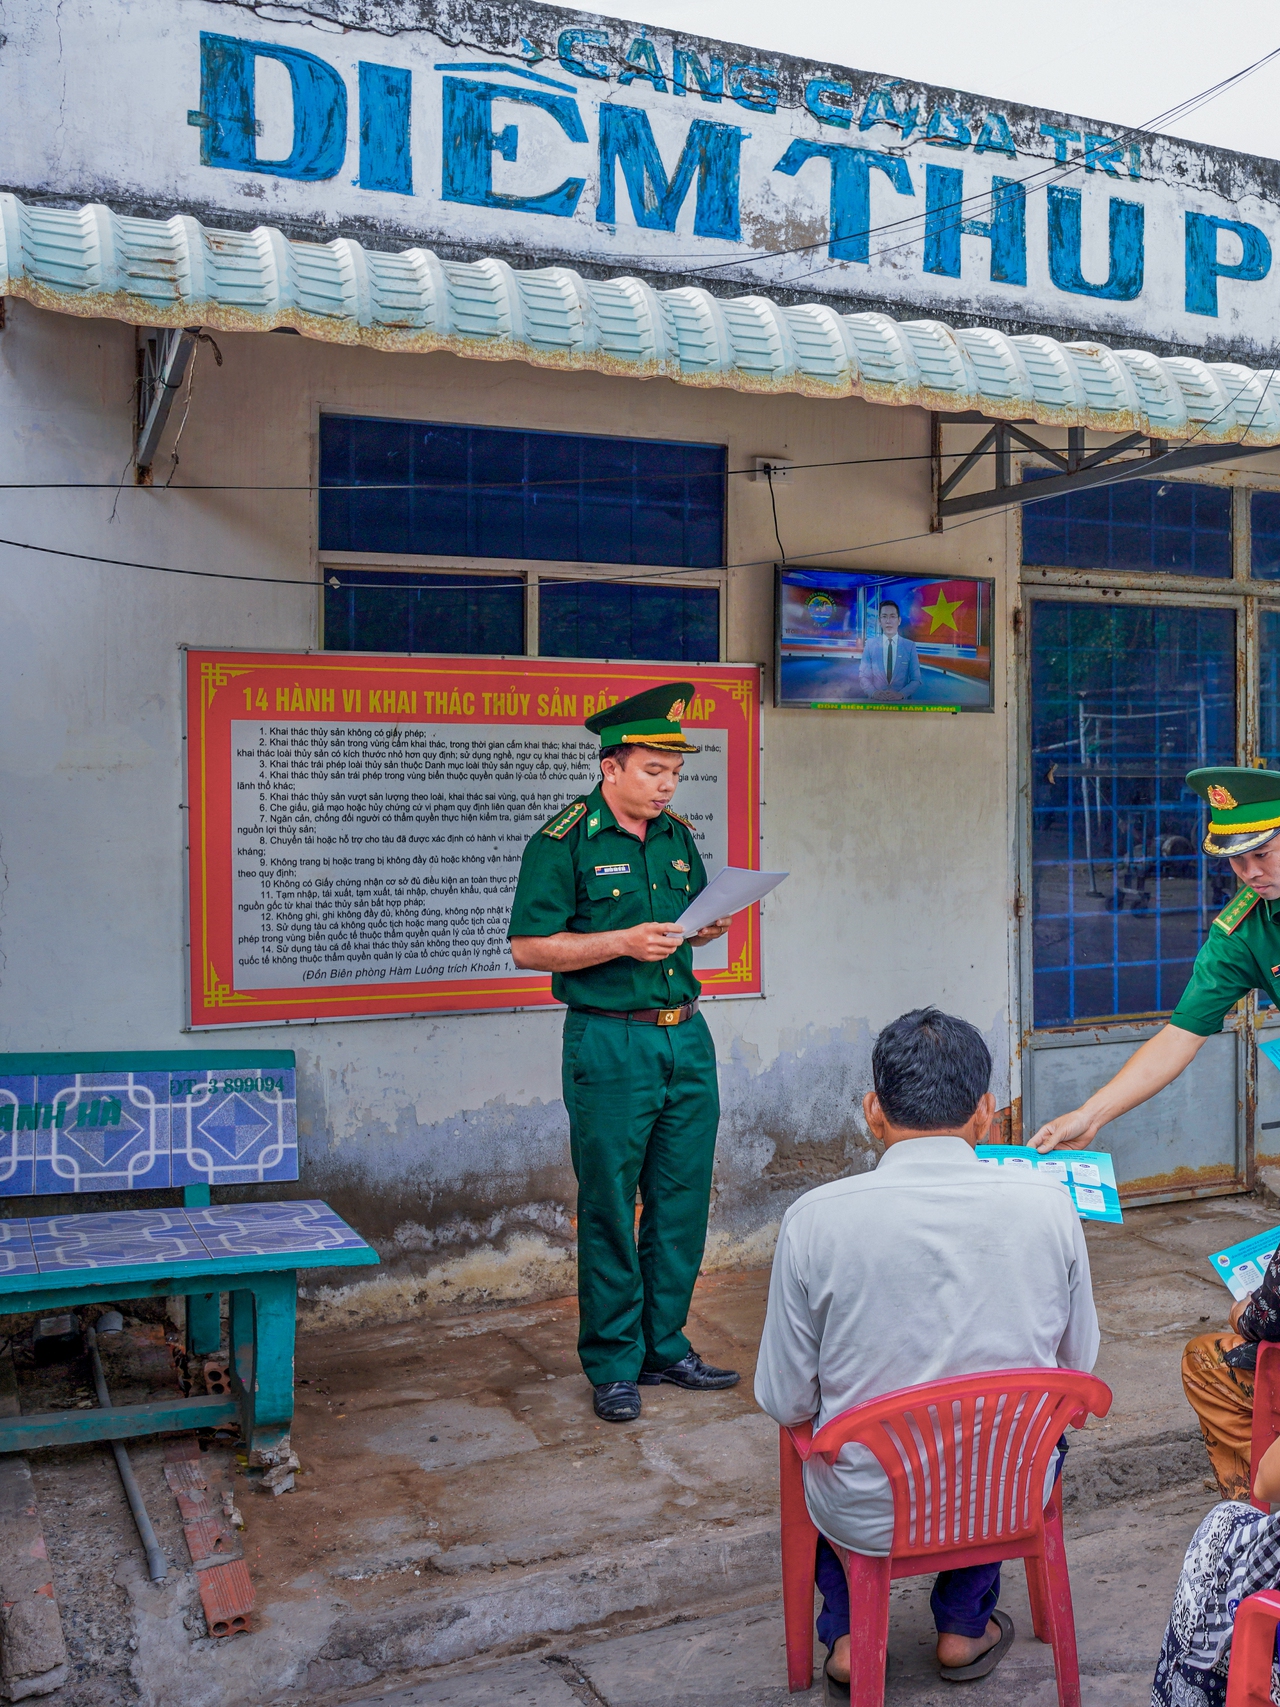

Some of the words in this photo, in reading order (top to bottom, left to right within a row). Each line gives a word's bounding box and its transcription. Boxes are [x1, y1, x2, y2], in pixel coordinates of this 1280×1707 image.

[1040, 123, 1141, 183] TRI
[773, 138, 1145, 301] THU
[243, 687, 268, 711] 14
[276, 683, 334, 712] HÀNH
[342, 689, 361, 713] VI
[369, 690, 417, 714] KHAI
[424, 686, 475, 715] THÁC
[482, 685, 531, 716] THỦY
[538, 686, 577, 718] SẢN
[290, 727, 309, 735] thác
[310, 727, 328, 737] thủy
[330, 728, 345, 736] sản
[347, 728, 372, 738] không
[374, 728, 384, 736] có
[310, 738, 328, 748] thủy
[330, 739, 345, 747] sản
[347, 740, 368, 749] trong
[370, 740, 390, 749] vùng
[391, 739, 409, 748] cấm
[449, 740, 470, 749] trong
[488, 740, 505, 750] gian
[506, 740, 523, 748] cấm
[326, 760, 346, 770] phép
[364, 760, 382, 770] thủy
[384, 760, 399, 768] sản
[400, 760, 422, 770] thuộc
[481, 761, 498, 771] thủy
[499, 761, 514, 769] sản
[515, 763, 534, 771] nguy
[236, 781, 256, 789] lãnh
[257, 780, 271, 789] thổ
[237, 824, 264, 834] nguồn
[266, 825, 277, 834] lợi
[278, 824, 297, 834] thủy
[238, 869, 257, 877] theo
[258, 870, 274, 878] quy
[275, 890, 295, 899] Tạm
[322, 889, 332, 897] tái
[356, 889, 372, 898] tạm
[395, 888, 405, 896] tái
[430, 886, 459, 897] chuyển
[483, 886, 498, 896] quá
[238, 902, 265, 912] nguồn
[266, 901, 282, 911] gốc
[284, 901, 294, 909] từ
[315, 900, 333, 908] thác
[334, 900, 352, 910] thủy
[354, 899, 369, 907] sản
[371, 899, 384, 907] bất
[386, 899, 402, 908] hợp
[276, 912, 303, 921] Không
[322, 911, 335, 920] ghi
[336, 910, 362, 920] không
[363, 909, 378, 919] đầy
[394, 908, 419, 918] không
[444, 907, 469, 916] không
[470, 906, 485, 916] nộp
[486, 906, 504, 915] nhật
[302, 969, 328, 982] (Đồn
[330, 969, 353, 978] Biên
[355, 967, 386, 979] phòng
[388, 966, 412, 975] Hàm
[414, 965, 445, 976] Luông
[447, 963, 468, 973] trích
[470, 962, 500, 971] Khoản
[222, 1076, 284, 1094] 899094
